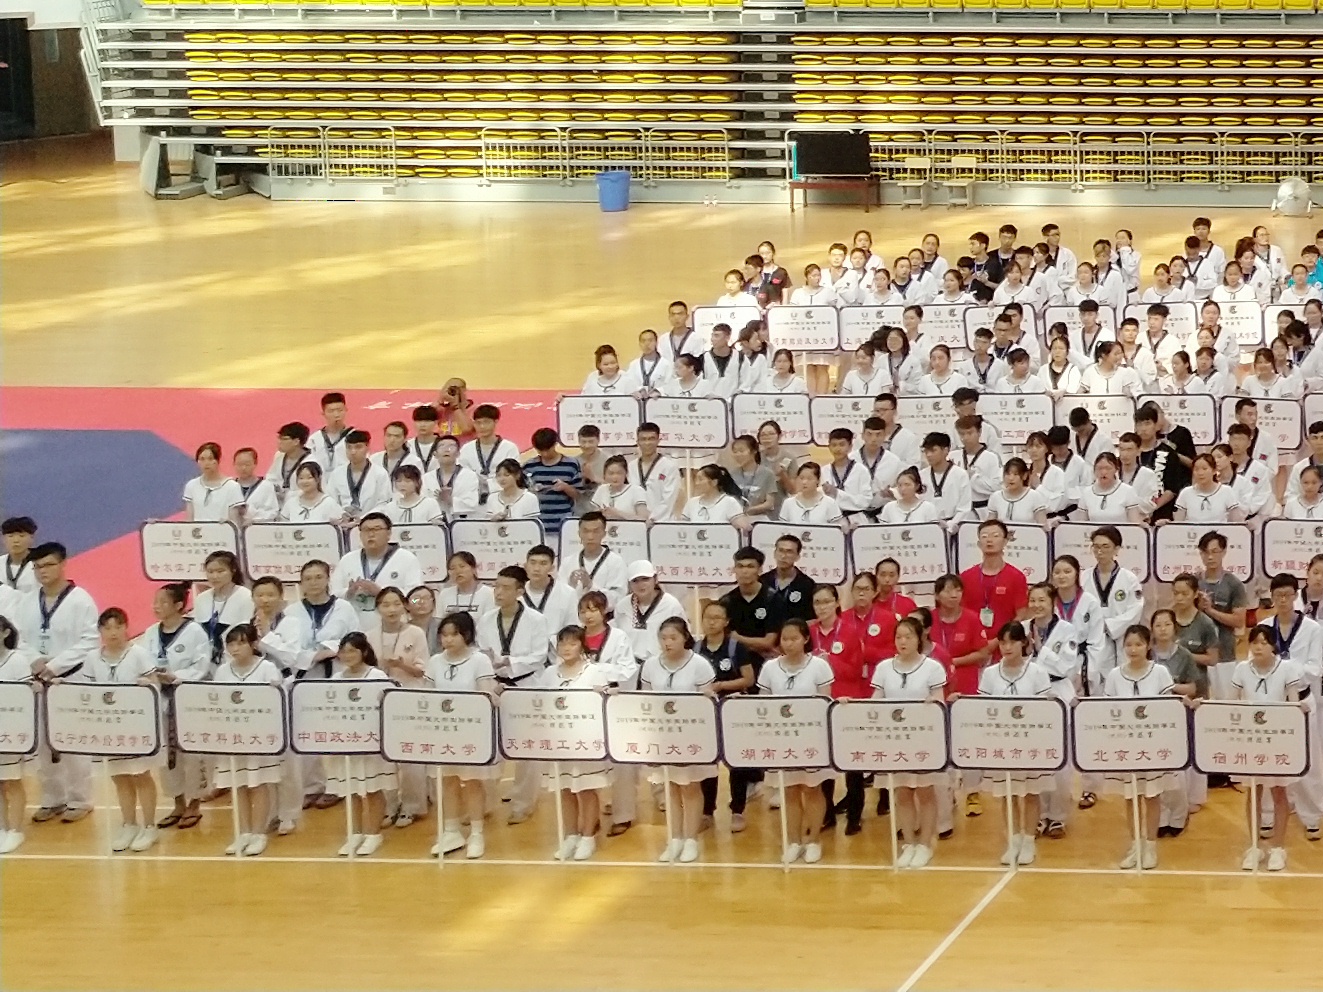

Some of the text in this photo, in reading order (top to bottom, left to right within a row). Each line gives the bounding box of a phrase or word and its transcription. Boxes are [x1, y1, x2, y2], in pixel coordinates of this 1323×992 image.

[183, 734, 279, 750] 北京科技大学
[298, 731, 380, 746] 中国政法大
[400, 741, 477, 756] 西南大学
[626, 742, 703, 757] 厦门大学
[741, 748, 819, 763] 湖南大学
[957, 747, 1059, 763] 沈阳城市学院
[1093, 749, 1172, 762] 北京大学
[850, 749, 930, 764] 南开大学
[1212, 751, 1291, 766] 宿州学院
